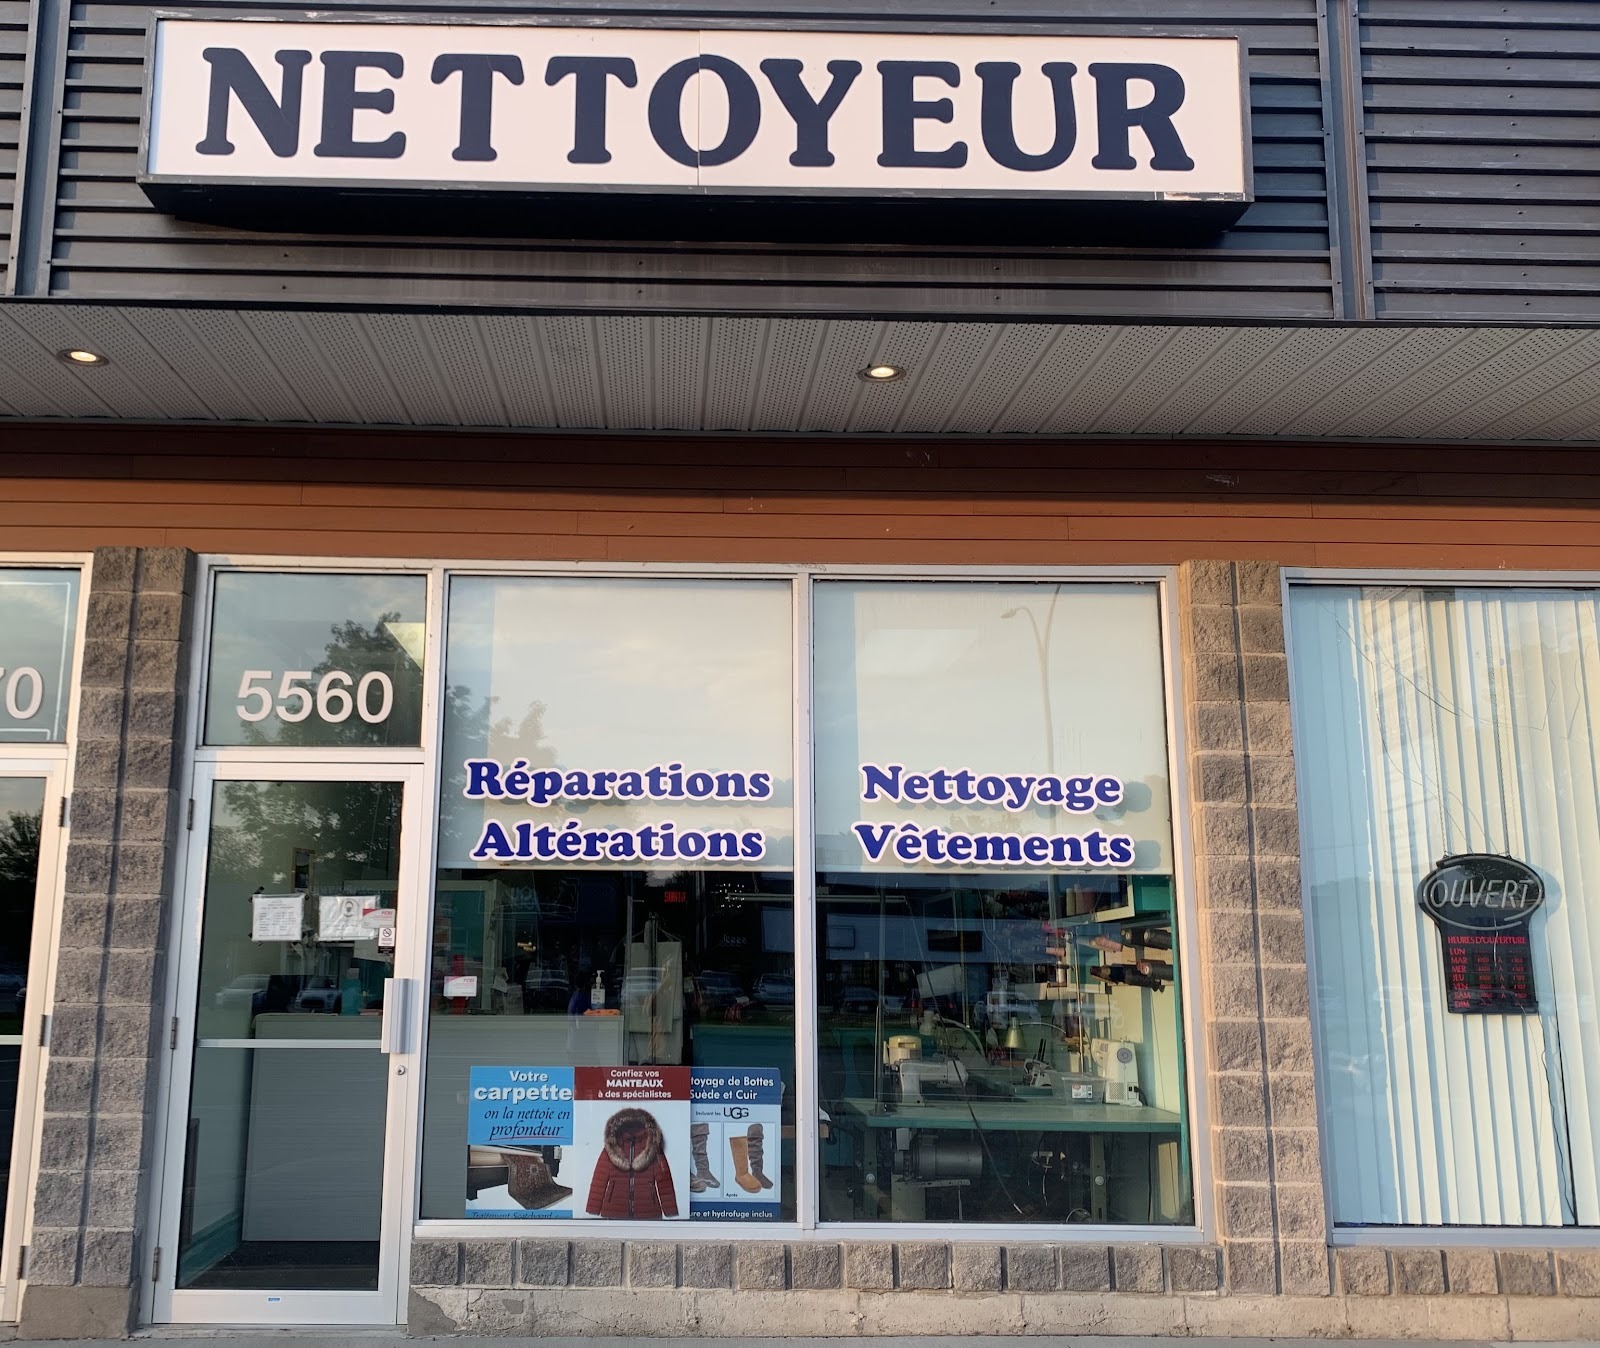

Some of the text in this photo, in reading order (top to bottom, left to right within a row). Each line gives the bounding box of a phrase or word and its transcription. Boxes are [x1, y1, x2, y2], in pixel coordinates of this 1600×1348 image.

[194, 47, 1195, 172] NETTOYEUR
[0, 666, 43, 720] 0
[236, 670, 394, 724] 5560
[464, 758, 773, 807] Réparations
[859, 763, 1124, 813] Nettoyage
[470, 818, 766, 861] Altérations
[852, 821, 1136, 867] Vêtements
[1430, 879, 1534, 909] OUVERT
[1447, 936, 1475, 944] HEURES
[1451, 965, 1467, 973] MER
[509, 1070, 548, 1082] Votre
[610, 1069, 643, 1077] Confiez
[606, 1079, 664, 1088] MANTEAUX
[728, 1075, 740, 1086] de
[743, 1076, 774, 1087] Bottes
[474, 1084, 573, 1104] carpette
[598, 1090, 672, 1099] à des spécialistes
[689, 1089, 757, 1100] Suède et Cuir
[484, 1106, 570, 1120] on la nettoie en
[723, 1107, 749, 1119] UGG
[489, 1120, 563, 1140] profondeur
[711, 1210, 749, 1218] hydrofuge
